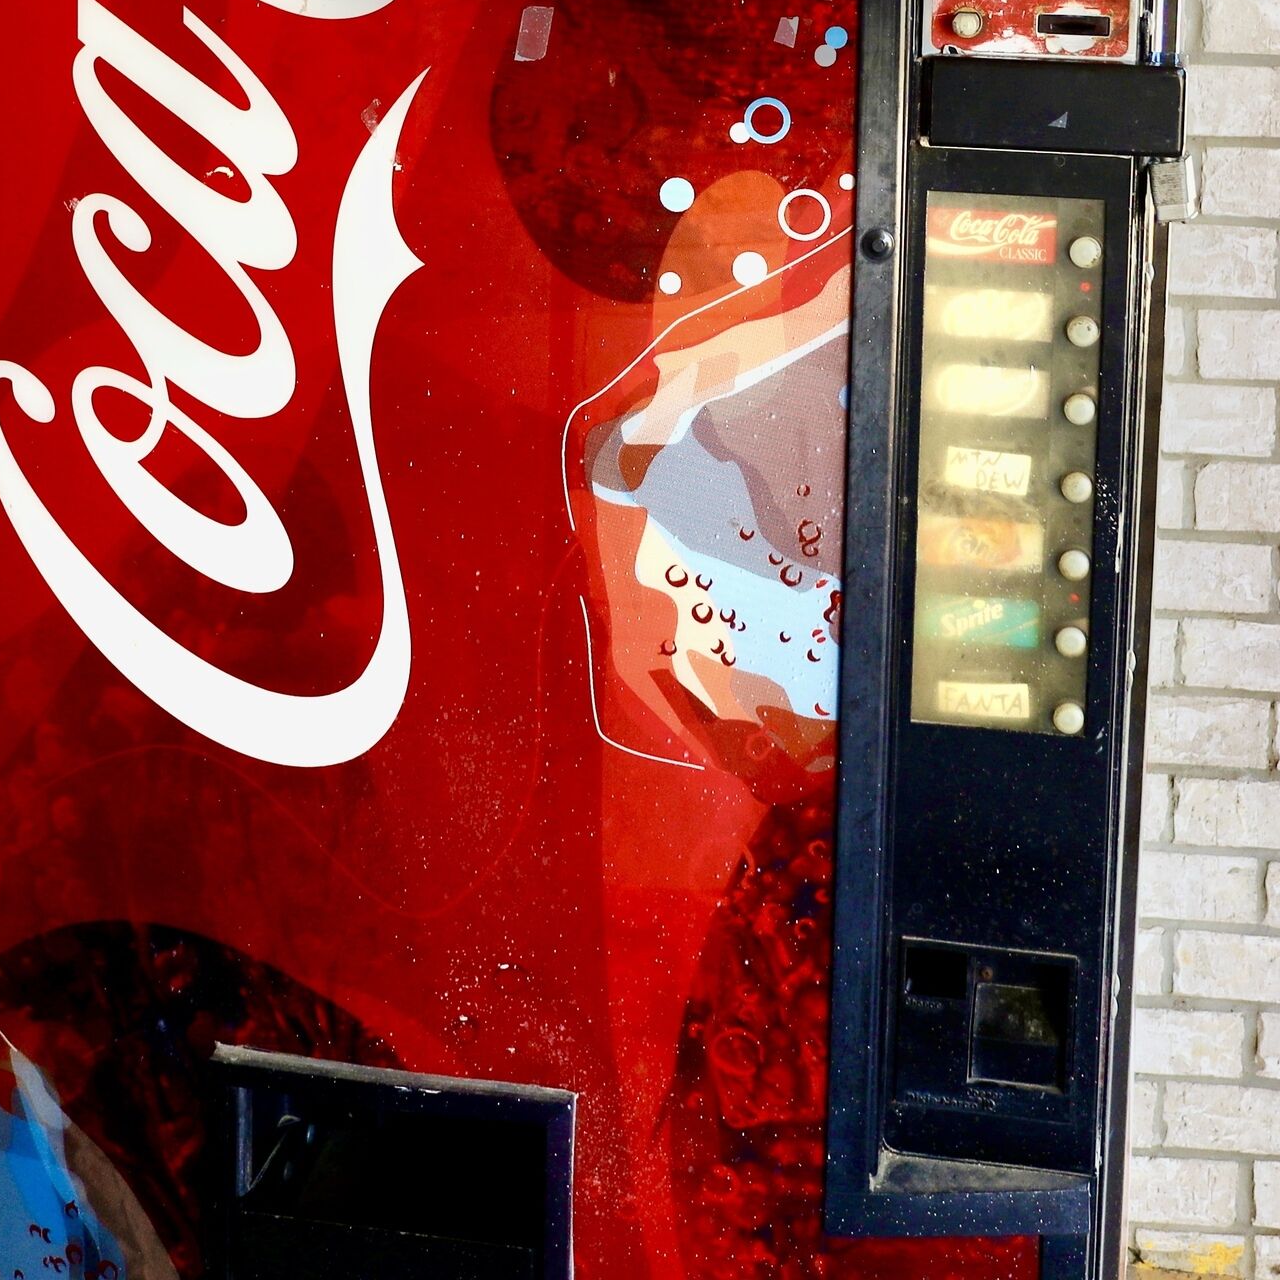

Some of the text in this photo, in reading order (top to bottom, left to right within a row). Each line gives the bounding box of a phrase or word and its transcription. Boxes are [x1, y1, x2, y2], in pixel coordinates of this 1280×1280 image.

[949, 210, 1045, 246] Coca-Cola
[999, 246, 1048, 262] CLASSIC
[975, 470, 1026, 490] DEW
[940, 599, 1004, 637] Sprite
[943, 687, 1024, 716] FANTA
